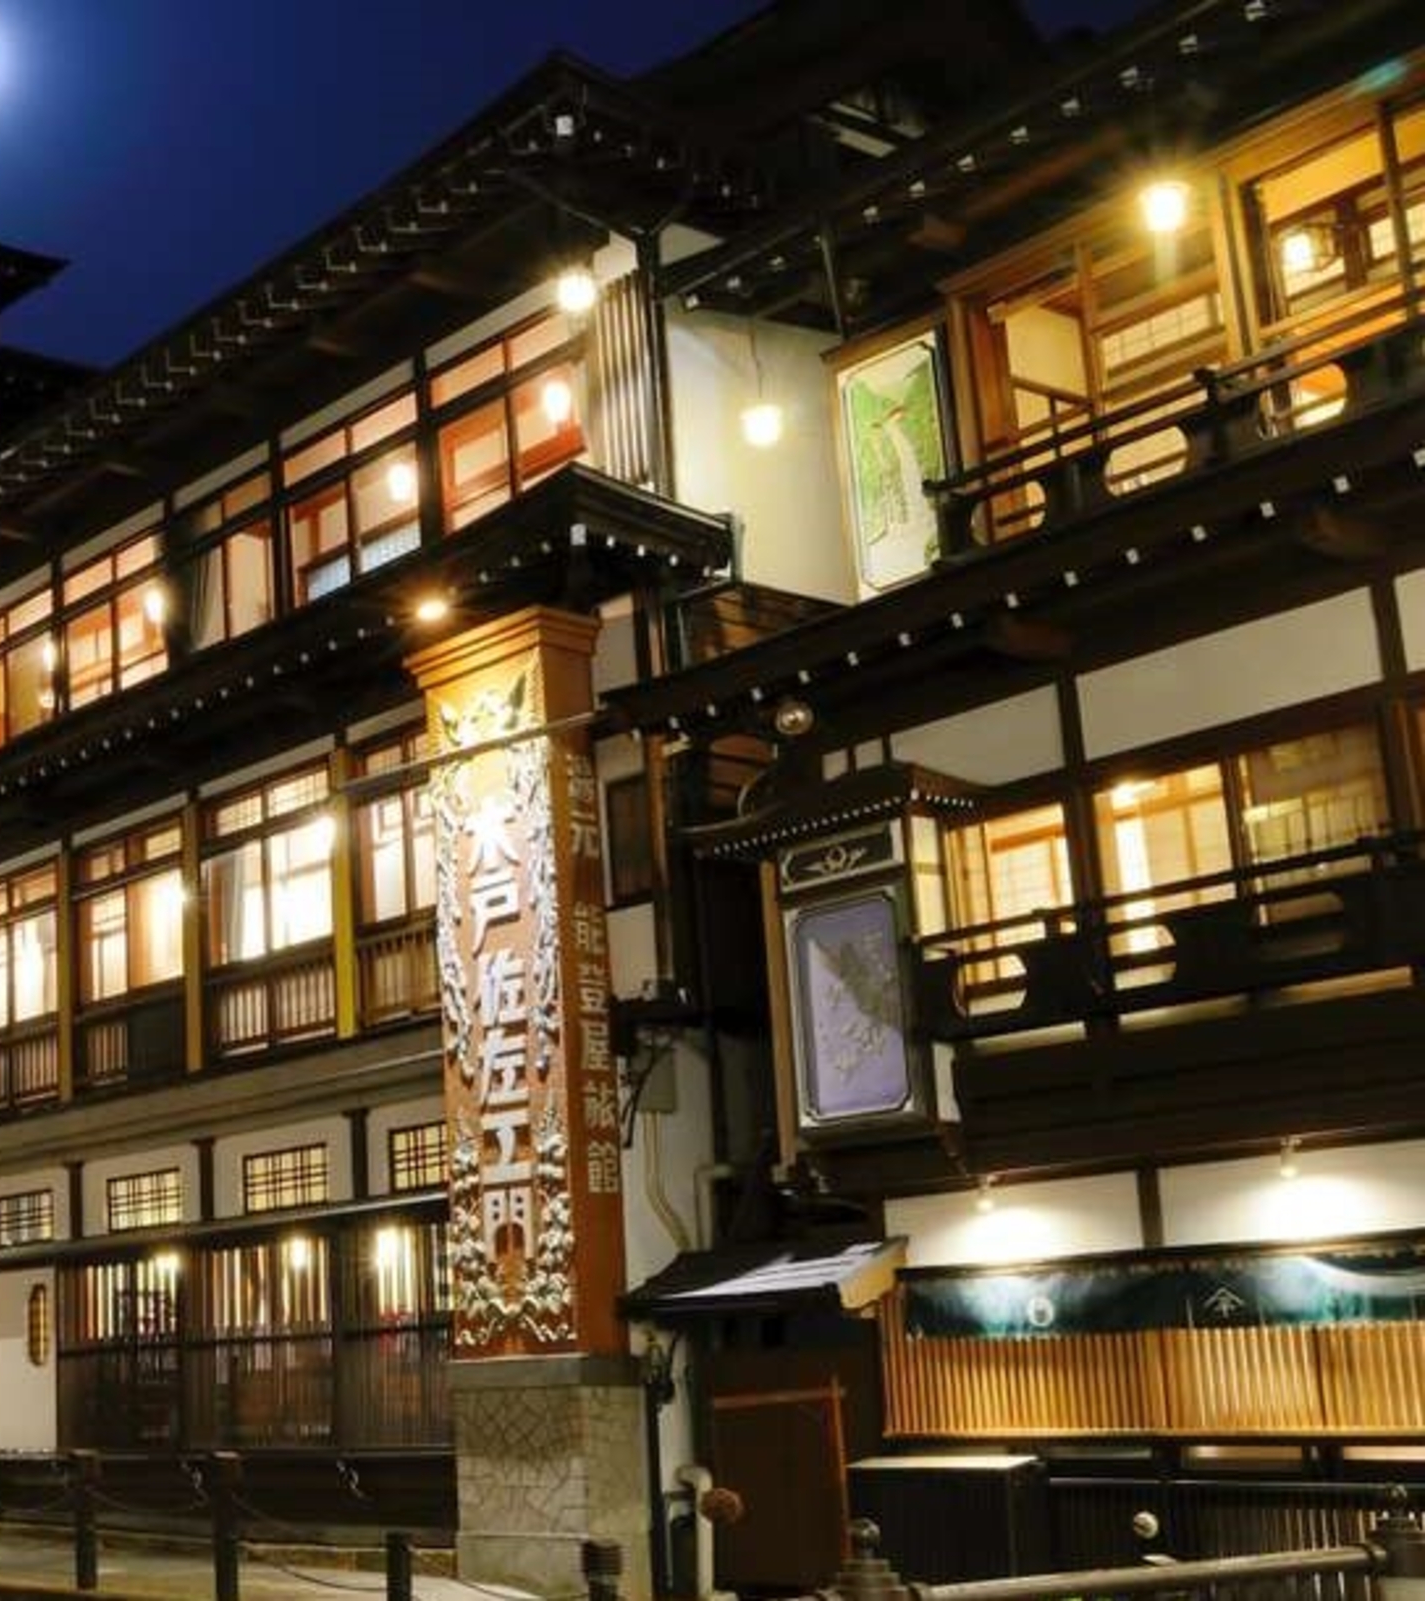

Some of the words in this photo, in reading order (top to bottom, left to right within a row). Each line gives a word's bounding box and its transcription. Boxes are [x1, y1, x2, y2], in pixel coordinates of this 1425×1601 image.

[575, 901, 619, 1194] 能登屋旅館
